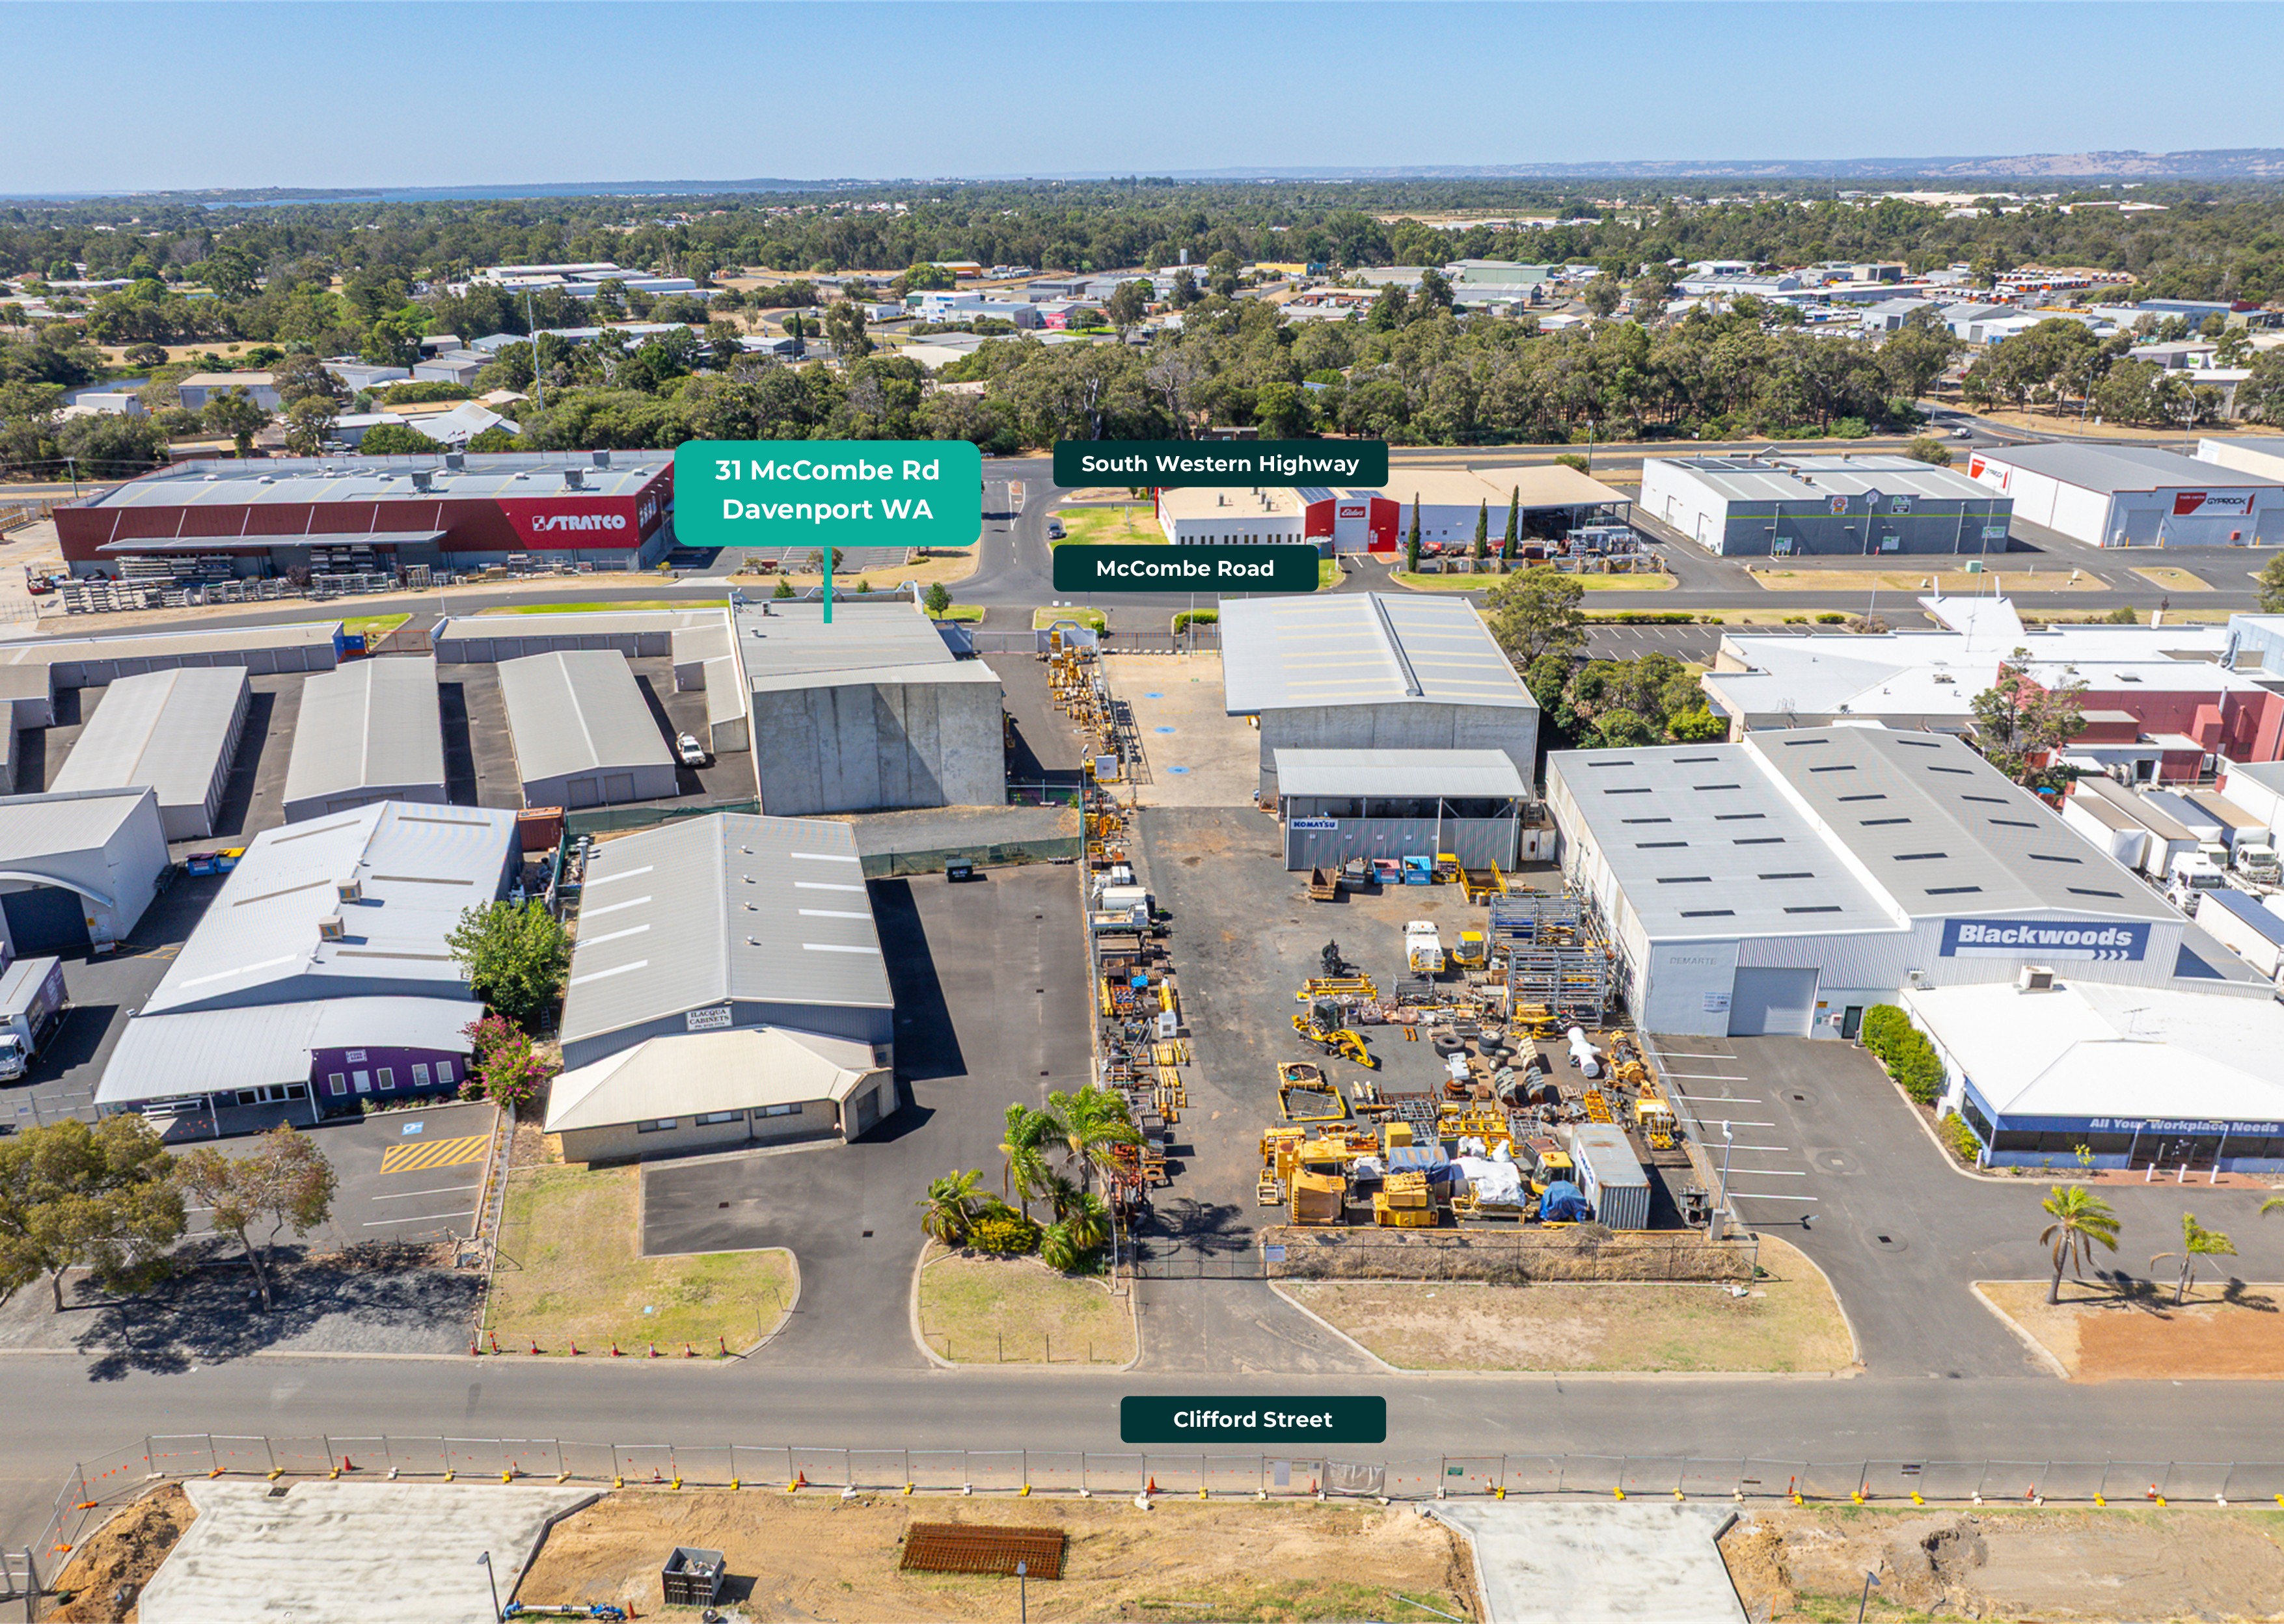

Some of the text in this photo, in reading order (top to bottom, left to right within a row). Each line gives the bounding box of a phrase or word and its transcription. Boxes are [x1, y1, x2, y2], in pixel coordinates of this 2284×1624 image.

[546, 515, 627, 531] STRATCO
[1294, 820, 1336, 828] KOMATSU
[1957, 924, 2133, 947] Blackwoods
[689, 1014, 730, 1025] CABINETS
[690, 1008, 727, 1018] ILACQUA
[2089, 1118, 2279, 1133] All Your Workplace Needs
